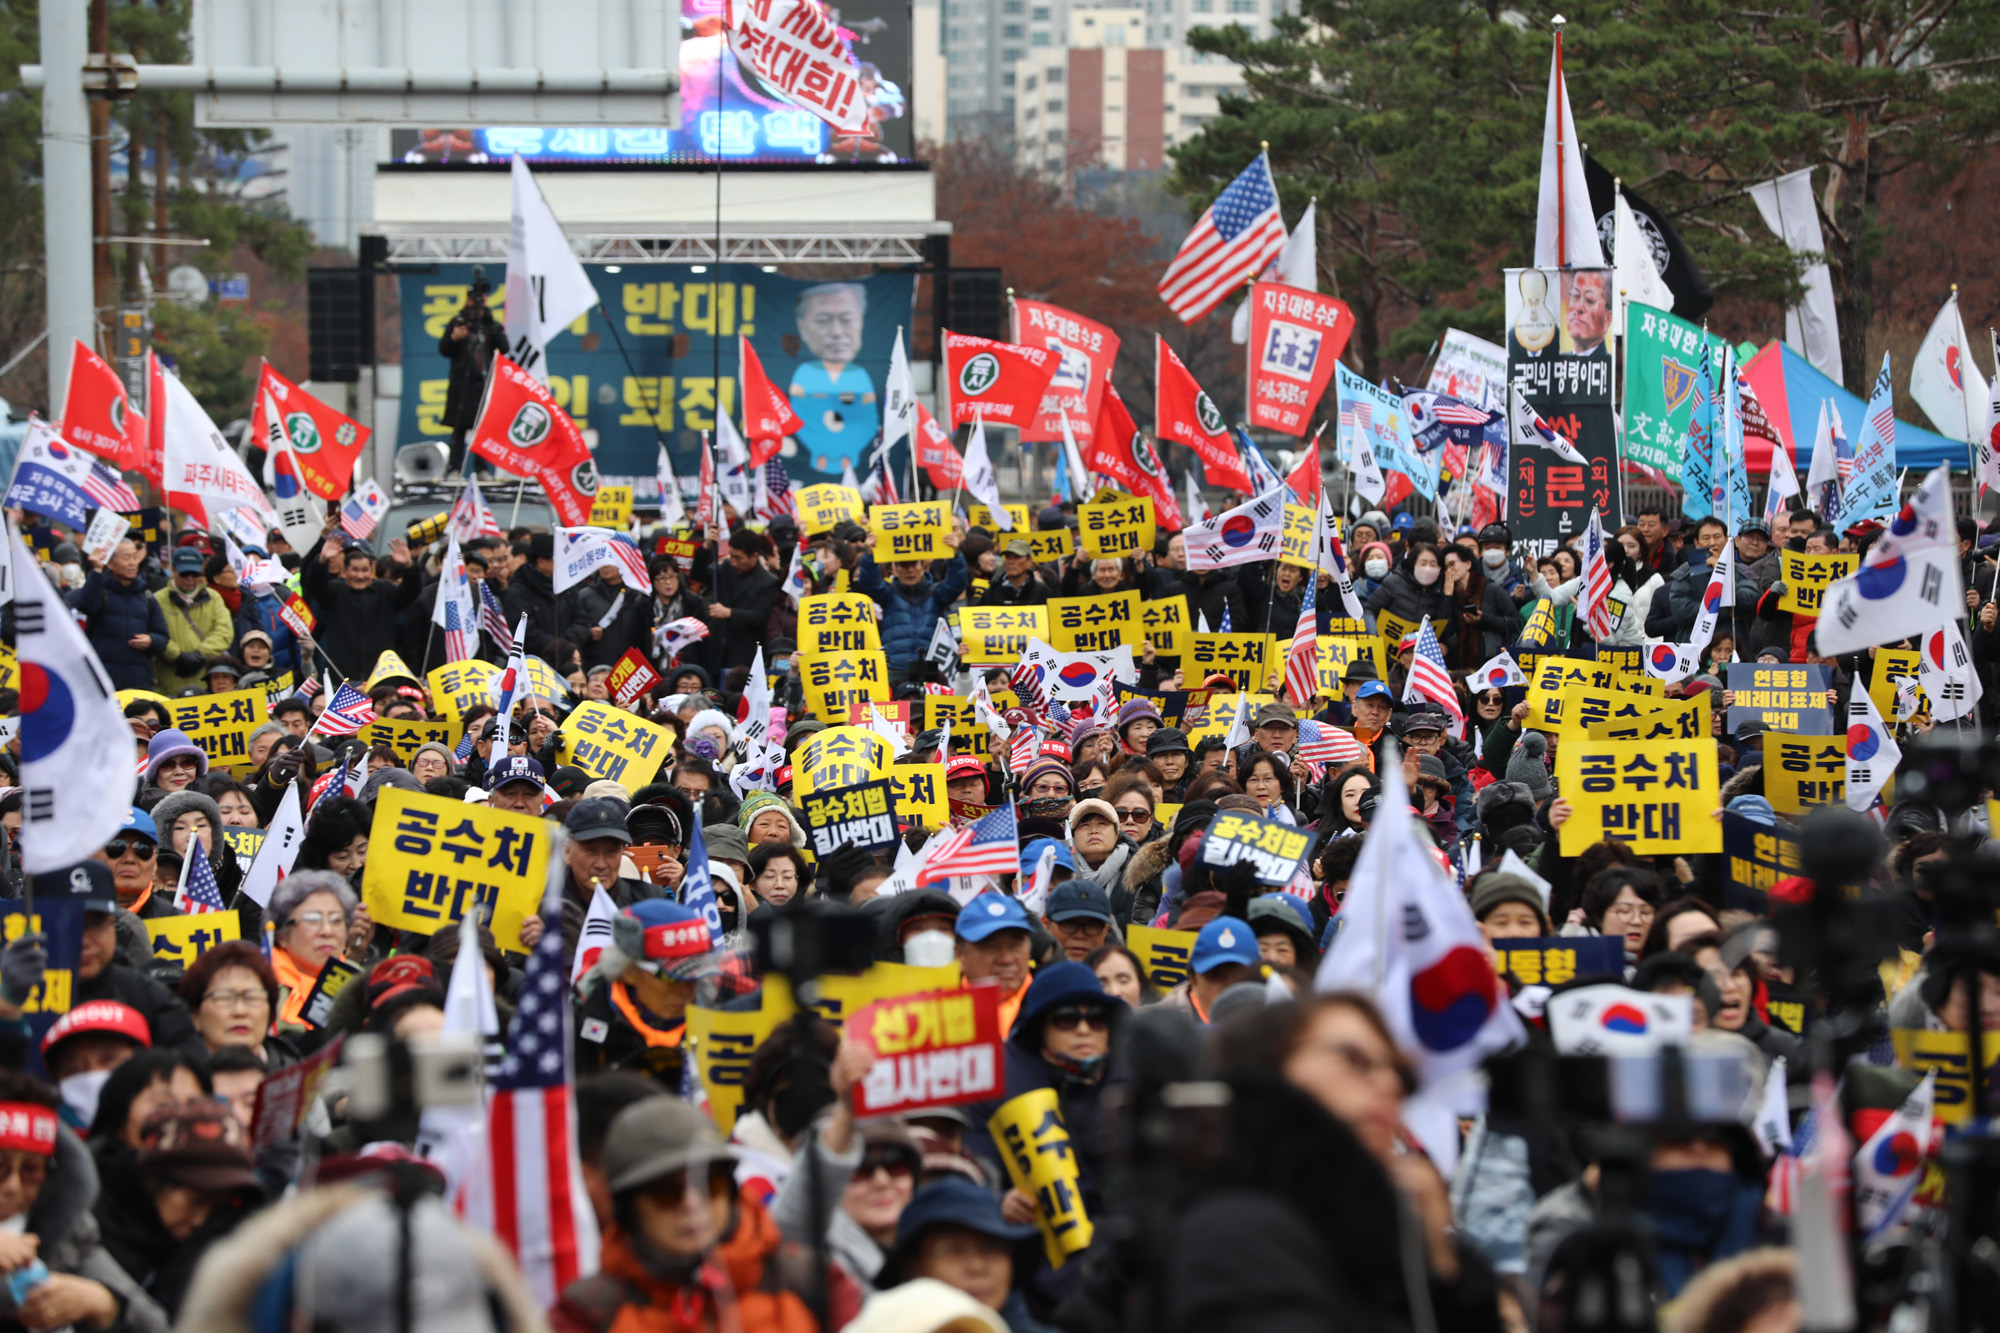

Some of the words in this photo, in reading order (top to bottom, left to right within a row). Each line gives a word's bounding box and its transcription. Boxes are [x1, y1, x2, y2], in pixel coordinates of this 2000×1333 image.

[740, 21, 858, 119] 탄대회!
[622, 282, 756, 336] 반대!
[1263, 290, 1340, 328] 자유대한수호
[1641, 312, 1725, 369] 자유대한호
[966, 359, 993, 388] 육사
[1514, 361, 1551, 397] 국민의
[1553, 360, 1608, 396] 명령이다!
[597, 490, 626, 504] 수처
[804, 487, 854, 507] 공수처
[1545, 466, 1585, 508] 문
[592, 507, 620, 522] 반대
[817, 507, 850, 526] 반대
[881, 508, 942, 530] 공수처
[977, 509, 1023, 526] 공처
[1088, 505, 1146, 529] 공수처
[1284, 509, 1315, 535] 공수
[1558, 511, 1573, 534] 은
[665, 541, 697, 558] 선거법
[893, 533, 933, 555] 반대
[1028, 536, 1064, 556] 수처
[1099, 531, 1139, 553] 반대
[567, 545, 608, 578] 한미동맹
[808, 600, 874, 625] 공수처
[972, 611, 1037, 629] 공수처
[1061, 598, 1131, 628] 공수처
[1142, 604, 1181, 627] 수처
[1329, 616, 1367, 633] 연동형
[818, 630, 865, 652] 반대
[984, 634, 1026, 656] 반대
[1074, 628, 1121, 652] 반대
[1194, 640, 1264, 663] 공수처
[810, 657, 879, 686] 공수처
[1598, 650, 1640, 667] 연동형
[440, 665, 494, 695] 공수
[609, 656, 637, 691] 선거법
[1319, 669, 1339, 691] 대
[1753, 669, 1808, 688] 연동형
[823, 689, 869, 716] 반대
[1734, 690, 1827, 710] 비례대표제
[176, 698, 255, 732] 공수처
[1761, 711, 1799, 730] 반대
[194, 731, 246, 758] 반대
[371, 724, 450, 750] 공수처
[575, 708, 659, 759] 공수처
[570, 740, 629, 783] 반대
[801, 733, 884, 774] 공수처
[813, 763, 870, 793] 반대
[1580, 751, 1700, 793] 공수처
[890, 773, 936, 806] 수처
[807, 784, 888, 828] 공수처법
[962, 803, 988, 819] 선거
[811, 813, 895, 857] 결사반대
[1601, 802, 1681, 842] 반대
[394, 806, 535, 877] 공수처
[1212, 815, 1309, 861] 공수처법
[1753, 832, 1801, 869] 연동
[402, 868, 500, 930] 반대
[872, 994, 976, 1054] 선거법
[862, 1042, 996, 1111] 결사반대
